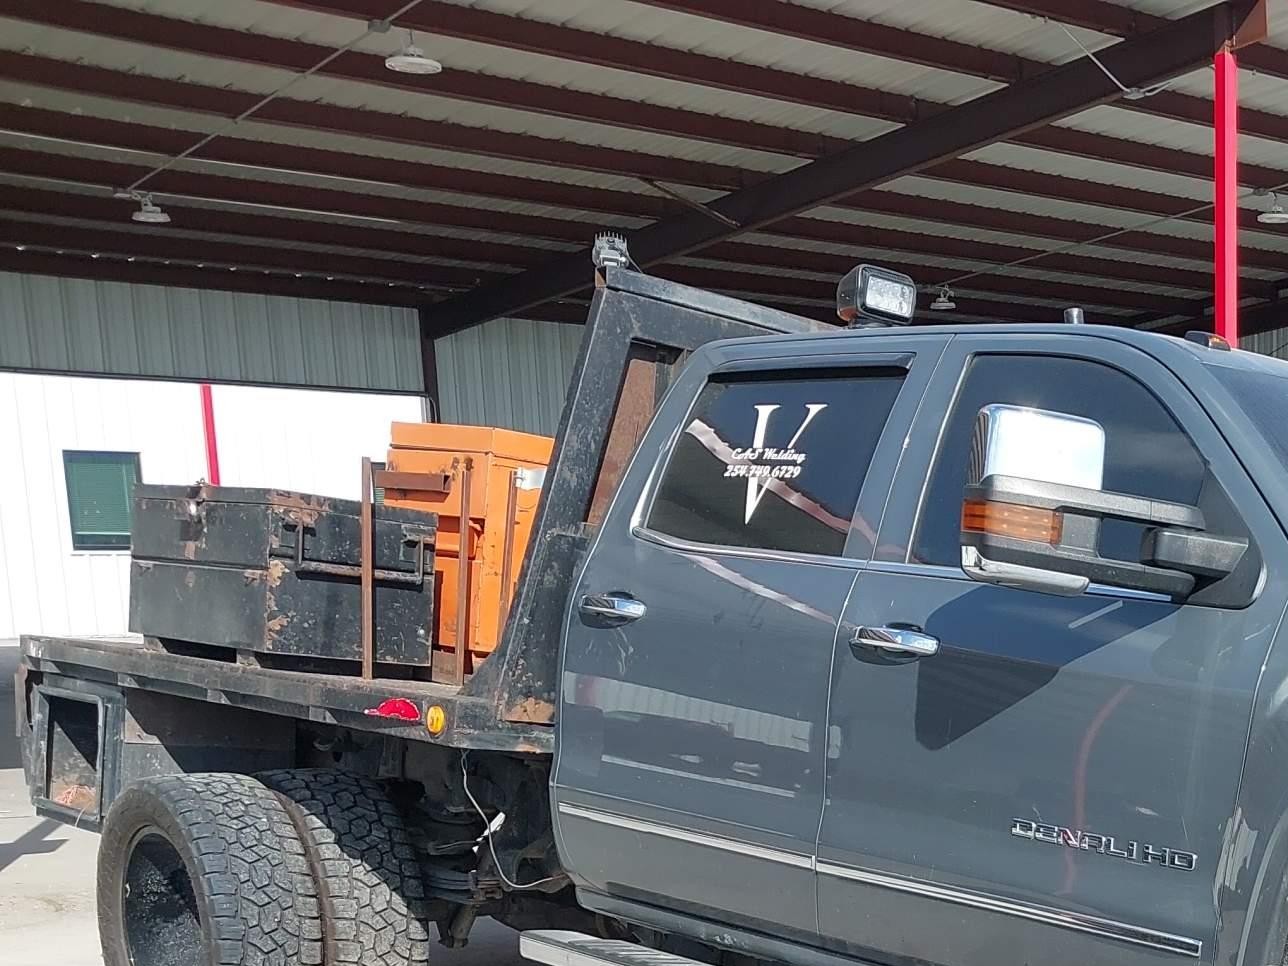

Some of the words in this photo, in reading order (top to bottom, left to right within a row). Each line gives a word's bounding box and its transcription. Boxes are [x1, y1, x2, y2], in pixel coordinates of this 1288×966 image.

[745, 403, 828, 525] V
[763, 447, 807, 464] Welding
[1011, 817, 1137, 860] DENALI
[1142, 844, 1199, 871] HD
